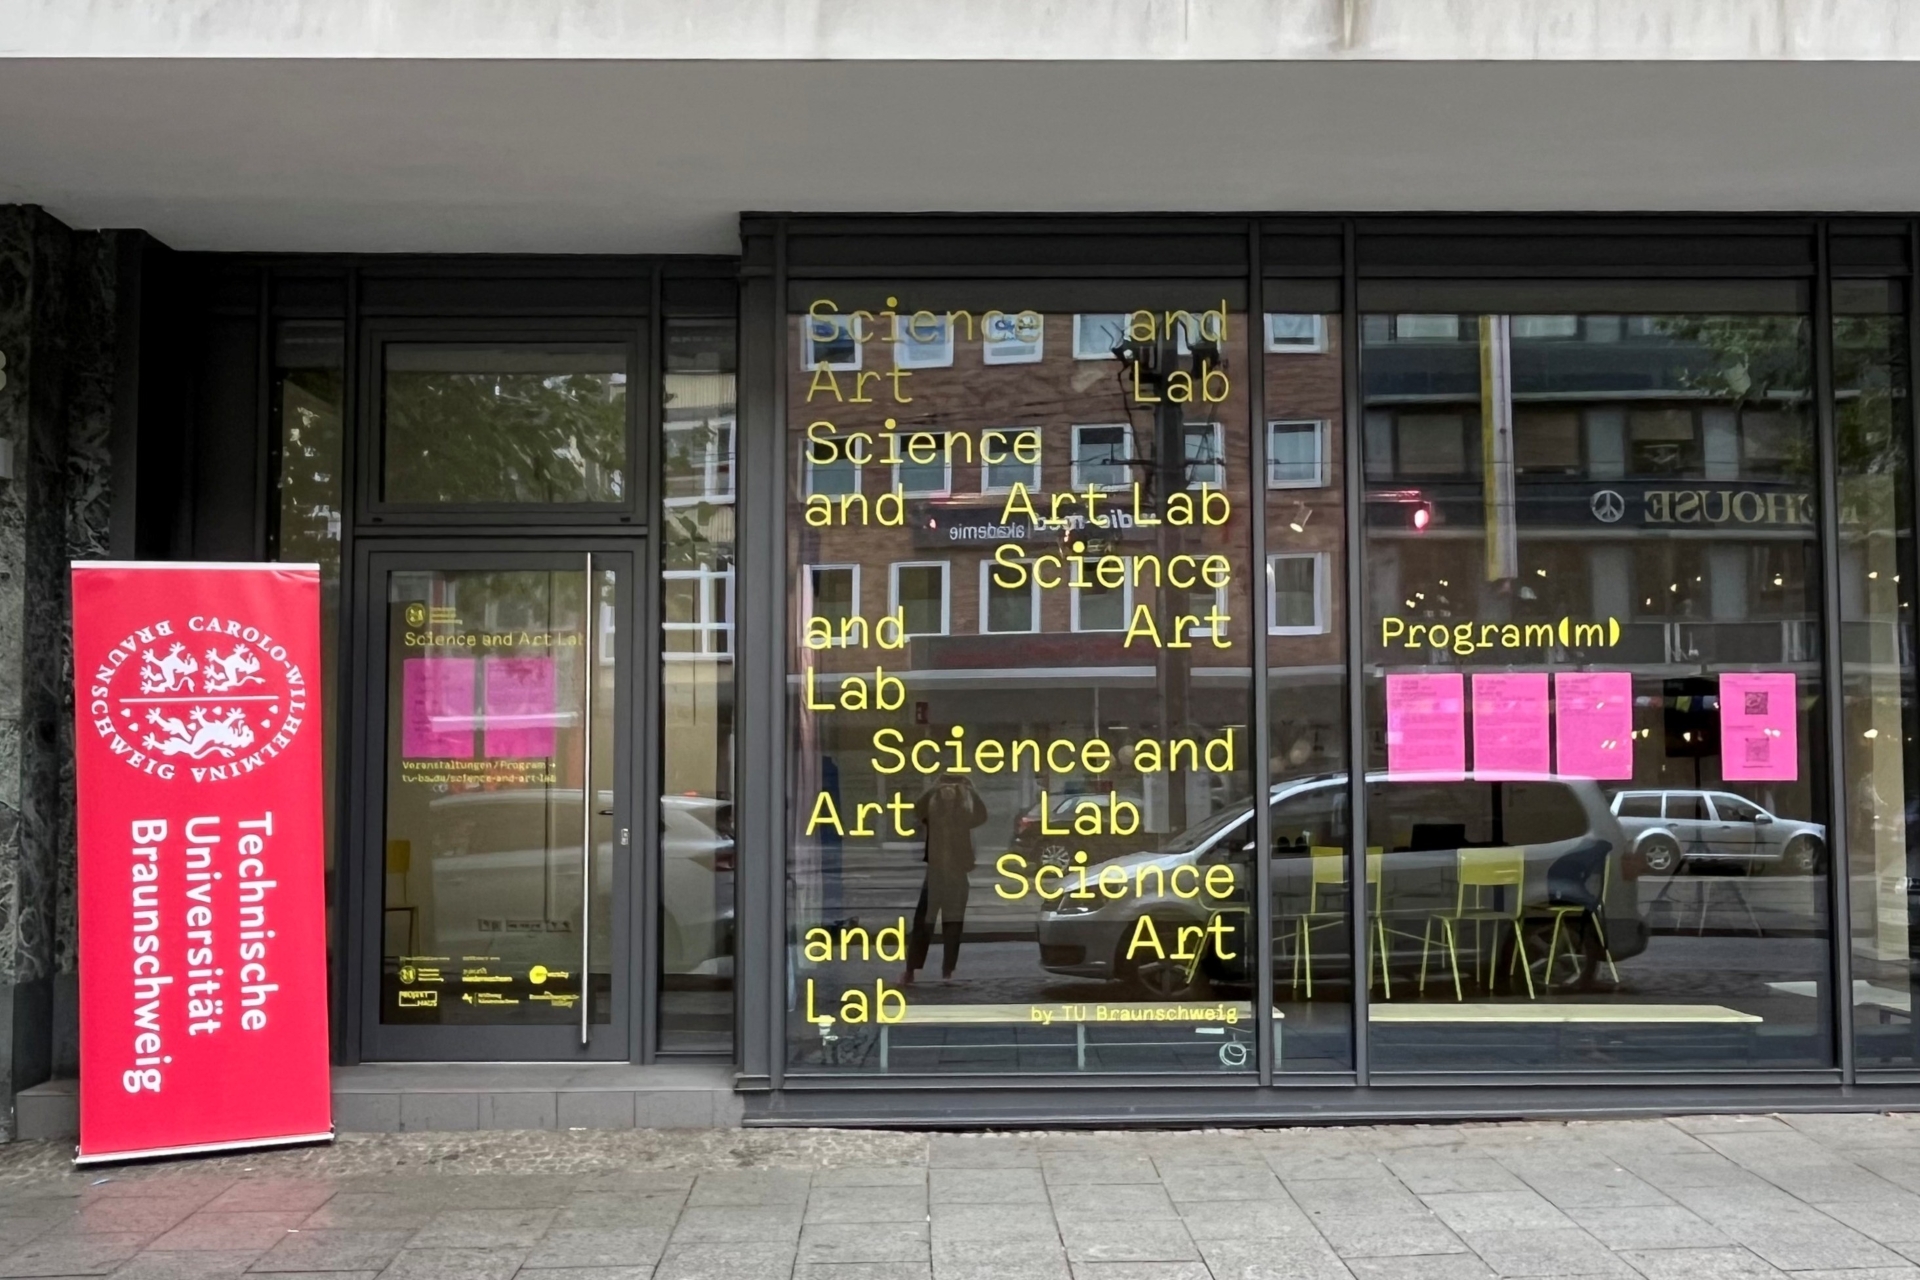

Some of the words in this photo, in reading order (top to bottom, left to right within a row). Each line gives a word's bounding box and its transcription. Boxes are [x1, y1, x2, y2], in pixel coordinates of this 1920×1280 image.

[808, 297, 1042, 342] Science
[1130, 299, 1228, 342] and
[807, 361, 914, 403] Art
[1133, 360, 1230, 403] Lab
[805, 418, 1042, 465] Science
[804, 483, 905, 527] and
[1000, 482, 1107, 526] Art
[1133, 482, 1231, 526] Lab
[993, 541, 1232, 589] Science
[404, 631, 477, 647] Science
[482, 631, 513, 647] and
[518, 631, 552, 647] Art
[804, 606, 905, 650] and
[1123, 604, 1233, 649] Art
[91, 620, 175, 780] BRAUNSCHWEIG
[805, 666, 906, 711] Lab
[871, 725, 1112, 774] Science
[1133, 728, 1235, 773] and
[805, 791, 916, 836] Art
[1040, 791, 1140, 836] Lab
[994, 851, 1235, 899] Science
[185, 816, 224, 1036] Universität
[238, 811, 279, 1031] Technische
[804, 917, 906, 962] and
[1126, 914, 1236, 960] Art
[122, 818, 174, 1093] Braunschweig
[805, 979, 906, 1024] Lab
[1031, 1006, 1053, 1025] by
[1062, 1005, 1086, 1020] TU
[1097, 1004, 1238, 1024] Braunschweig
